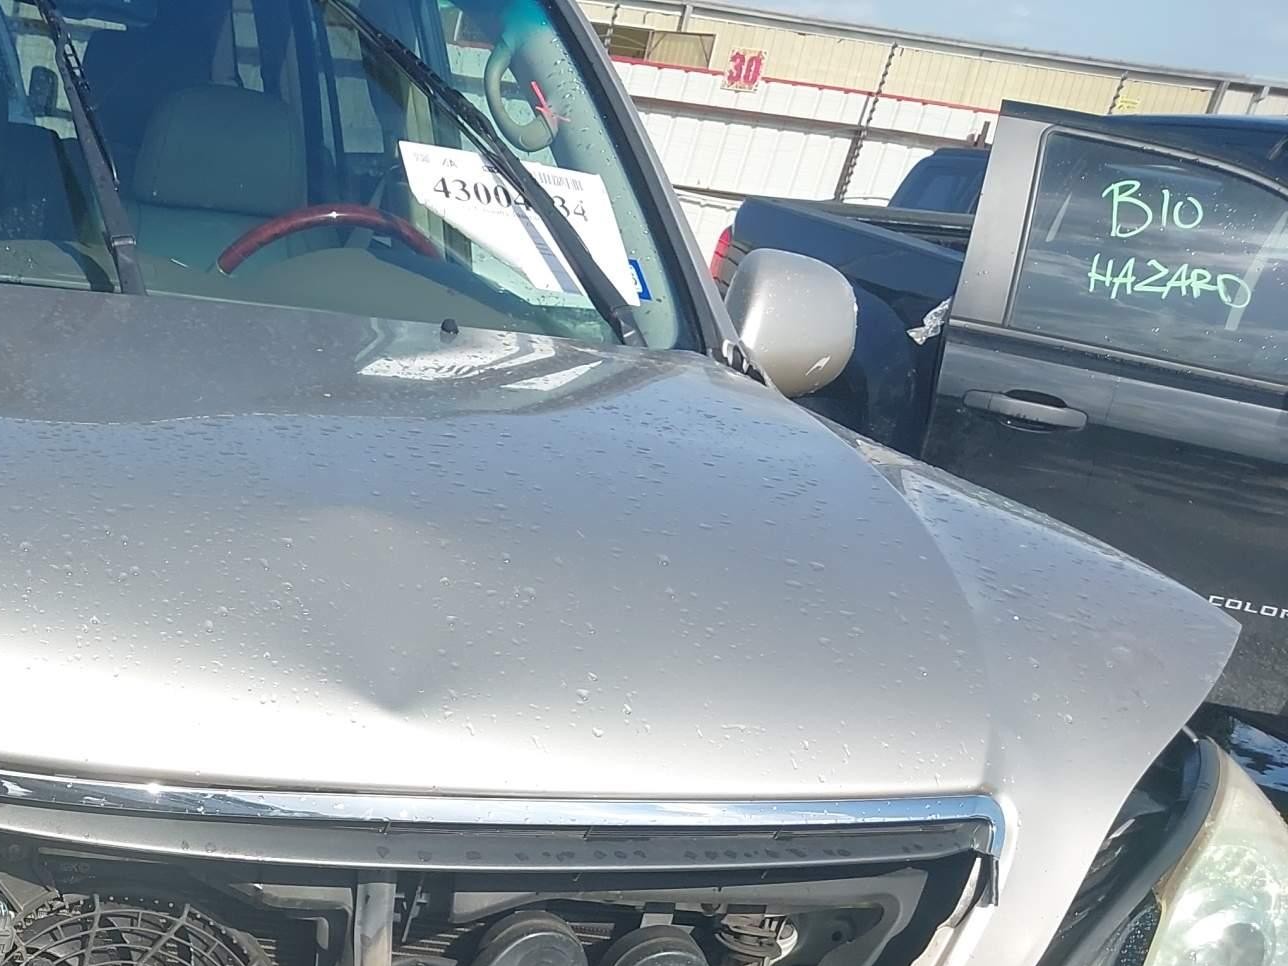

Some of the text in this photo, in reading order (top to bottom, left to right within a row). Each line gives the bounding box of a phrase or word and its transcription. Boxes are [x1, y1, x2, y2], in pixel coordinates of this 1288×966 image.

[727, 52, 761, 87] 30
[433, 177, 588, 222] 4300434
[1102, 180, 1204, 238] BIO
[1088, 253, 1252, 308] HAZARD
